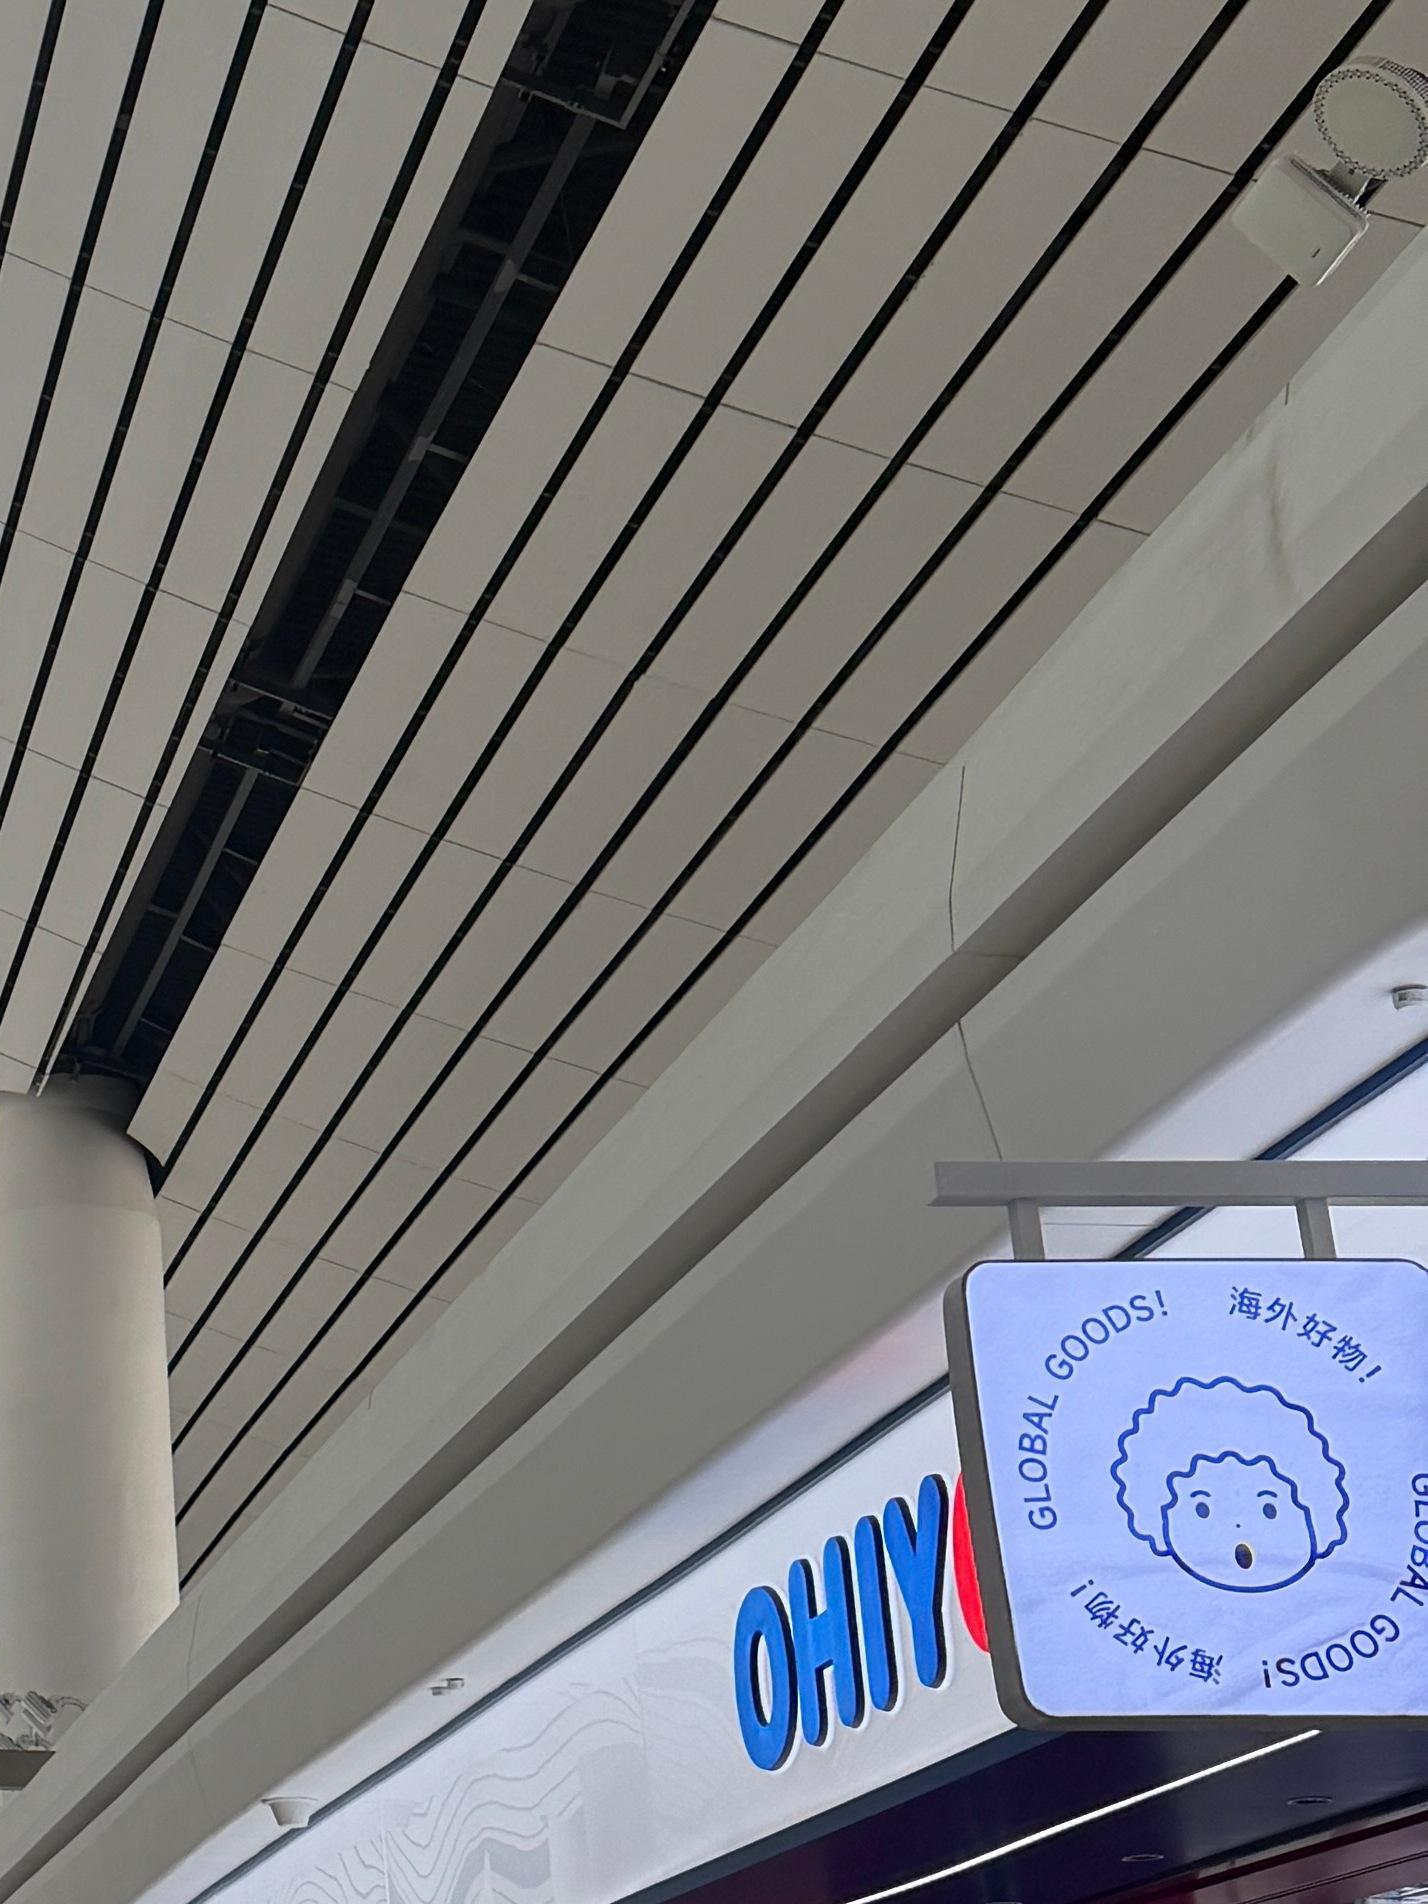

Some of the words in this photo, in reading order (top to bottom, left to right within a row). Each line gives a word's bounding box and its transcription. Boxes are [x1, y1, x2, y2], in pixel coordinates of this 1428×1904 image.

[1227, 1285, 1382, 1383] 海外好物!
[1017, 1394, 1058, 1531] GLOBAL
[1043, 1290, 1168, 1380] GOODS!
[1069, 1577, 1223, 1684] 海外好物!
[1261, 1614, 1401, 1689] GOODS!
